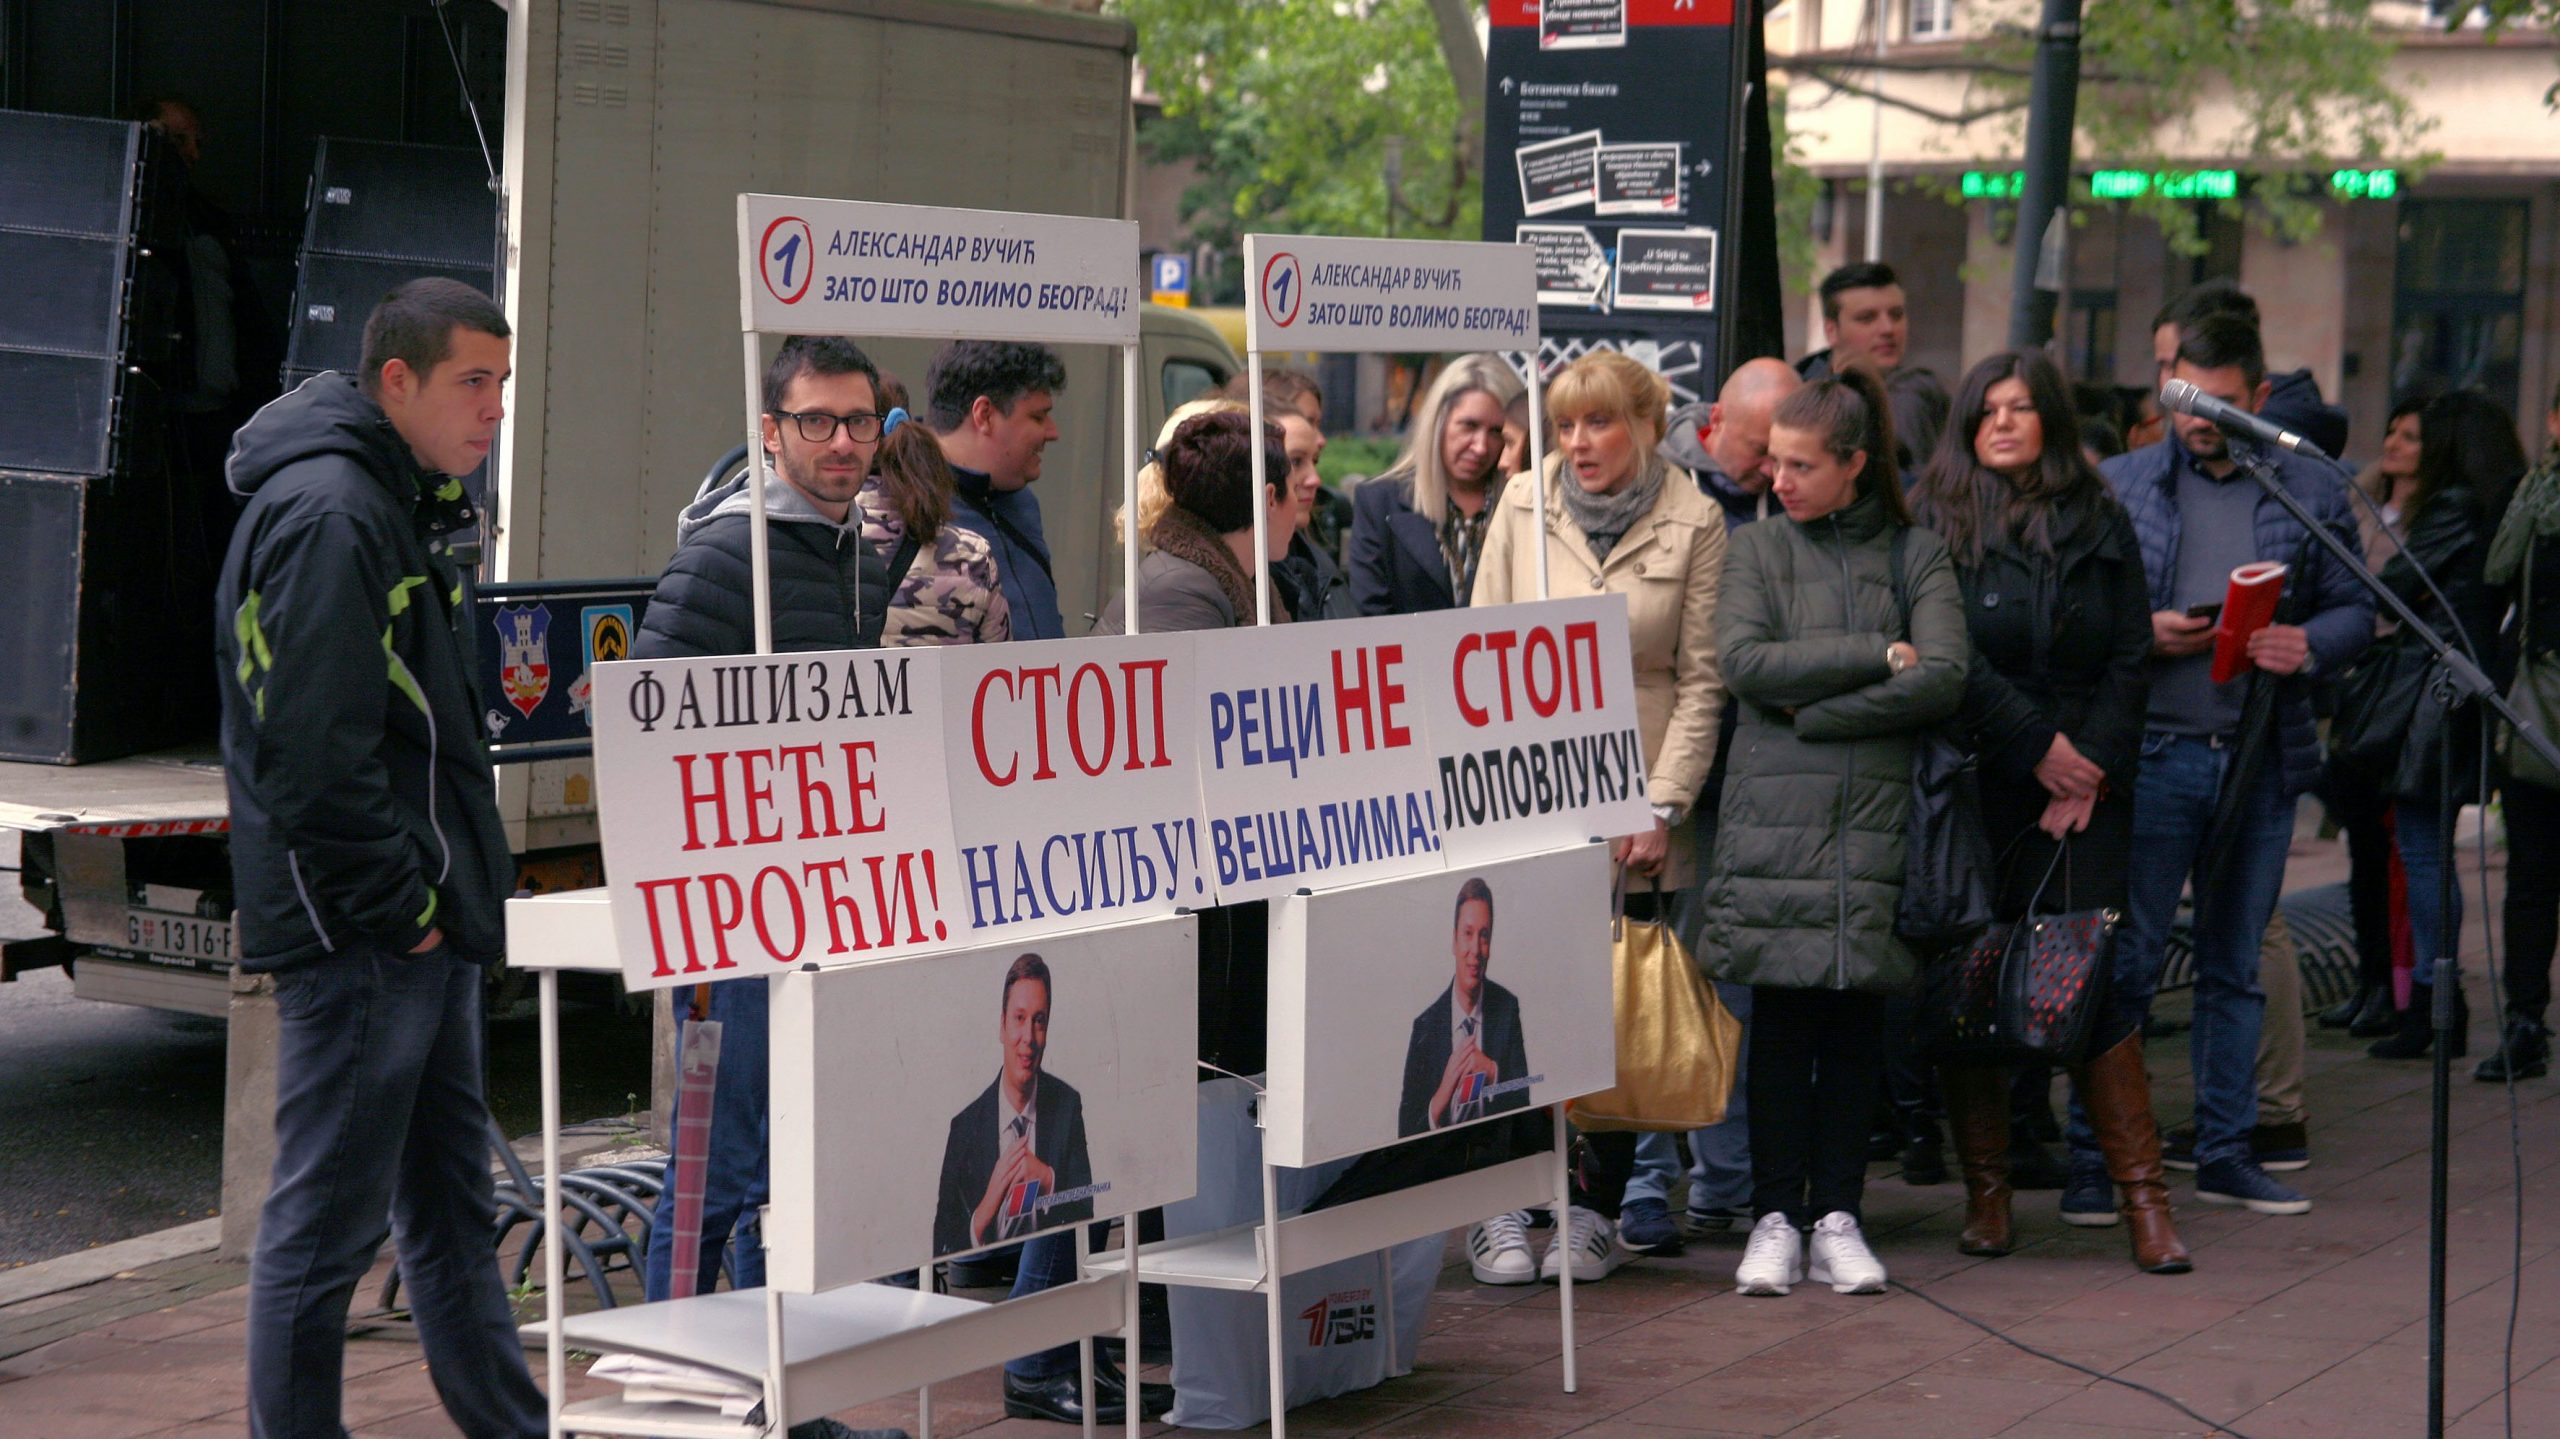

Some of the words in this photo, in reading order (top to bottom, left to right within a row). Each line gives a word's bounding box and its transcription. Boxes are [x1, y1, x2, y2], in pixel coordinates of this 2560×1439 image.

[1520, 81, 1580, 96] Ботаничка
[1582, 81, 1619, 96] башта
[774, 234, 801, 287] 1
[828, 230, 966, 266] АЛЕКСАНДАР
[971, 238, 1034, 264] ВУЧИЋ
[1160, 259, 1181, 288] P
[1655, 249, 1677, 261] Srbiji
[1679, 252, 1689, 260] su
[824, 276, 876, 302] ЗАТО
[881, 279, 928, 304] ШТО
[937, 280, 1031, 308] ВОЛИМО
[1038, 284, 1127, 318] БЕОГРАД!
[1273, 268, 1293, 313] 1
[1312, 264, 1410, 293] АЛЕКСАНДАР
[1414, 269, 1460, 290] ВУЧИЋ
[1308, 303, 1345, 325] ЗАТО
[1349, 305, 1383, 326] ШТО
[1390, 305, 1459, 328] ВОЛИМО
[1464, 308, 1529, 336] БЕОГРАД!
[631, 658, 912, 731] ФАШИЗАМ
[1454, 622, 1603, 726] СТОП
[973, 660, 1171, 786] СТОП
[1210, 683, 1325, 778] РЕЦИ
[1332, 645, 1411, 753] НЕ
[674, 741, 885, 851] НЕЋЕ
[1439, 730, 1643, 830] ЛОПОВЛУКУ!
[1212, 792, 1440, 885] ВЕШАЛИМА!
[964, 818, 1202, 928] НАСИЉУ!
[128, 915, 139, 945] G
[636, 849, 947, 977] ПРОЋИ!
